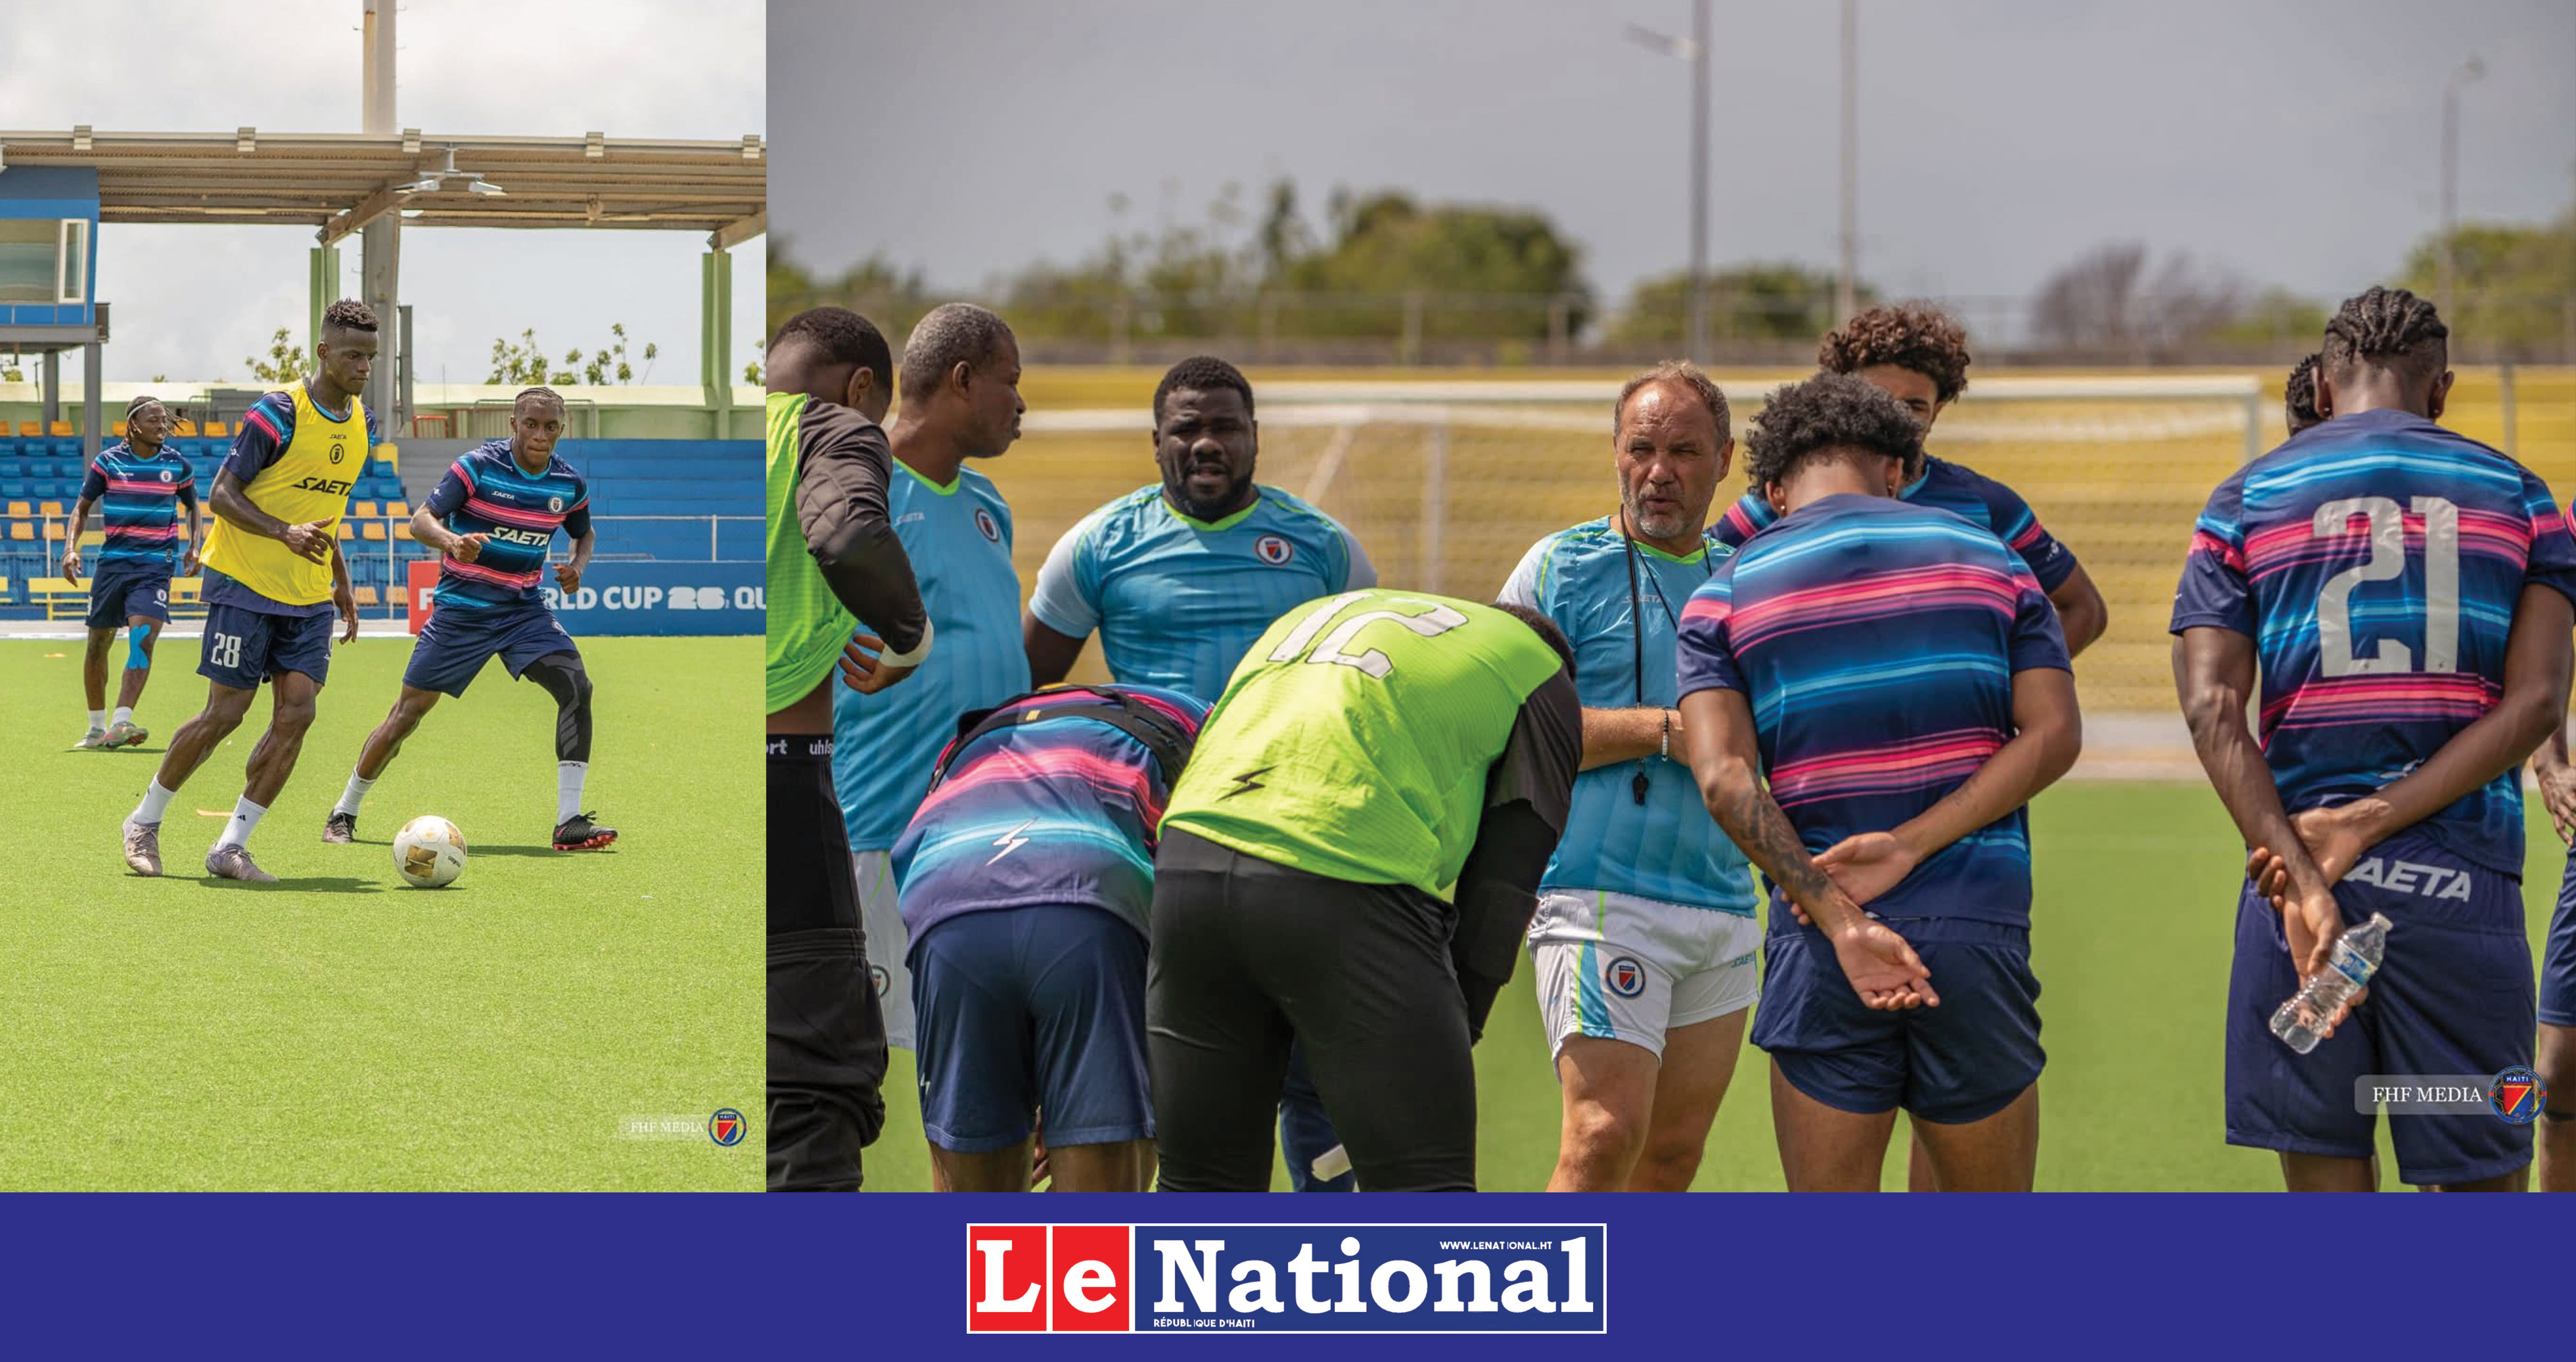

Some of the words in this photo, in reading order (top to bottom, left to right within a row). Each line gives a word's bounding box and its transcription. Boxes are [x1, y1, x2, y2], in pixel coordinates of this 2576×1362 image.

[492, 490, 515, 500] SAETA
[540, 586, 597, 610] RLD
[603, 586, 663, 610] CUP
[2312, 496, 2459, 678] 21
[210, 632, 242, 668] 28
[1266, 592, 1469, 680] 12
[2341, 855, 2471, 902] AETA
